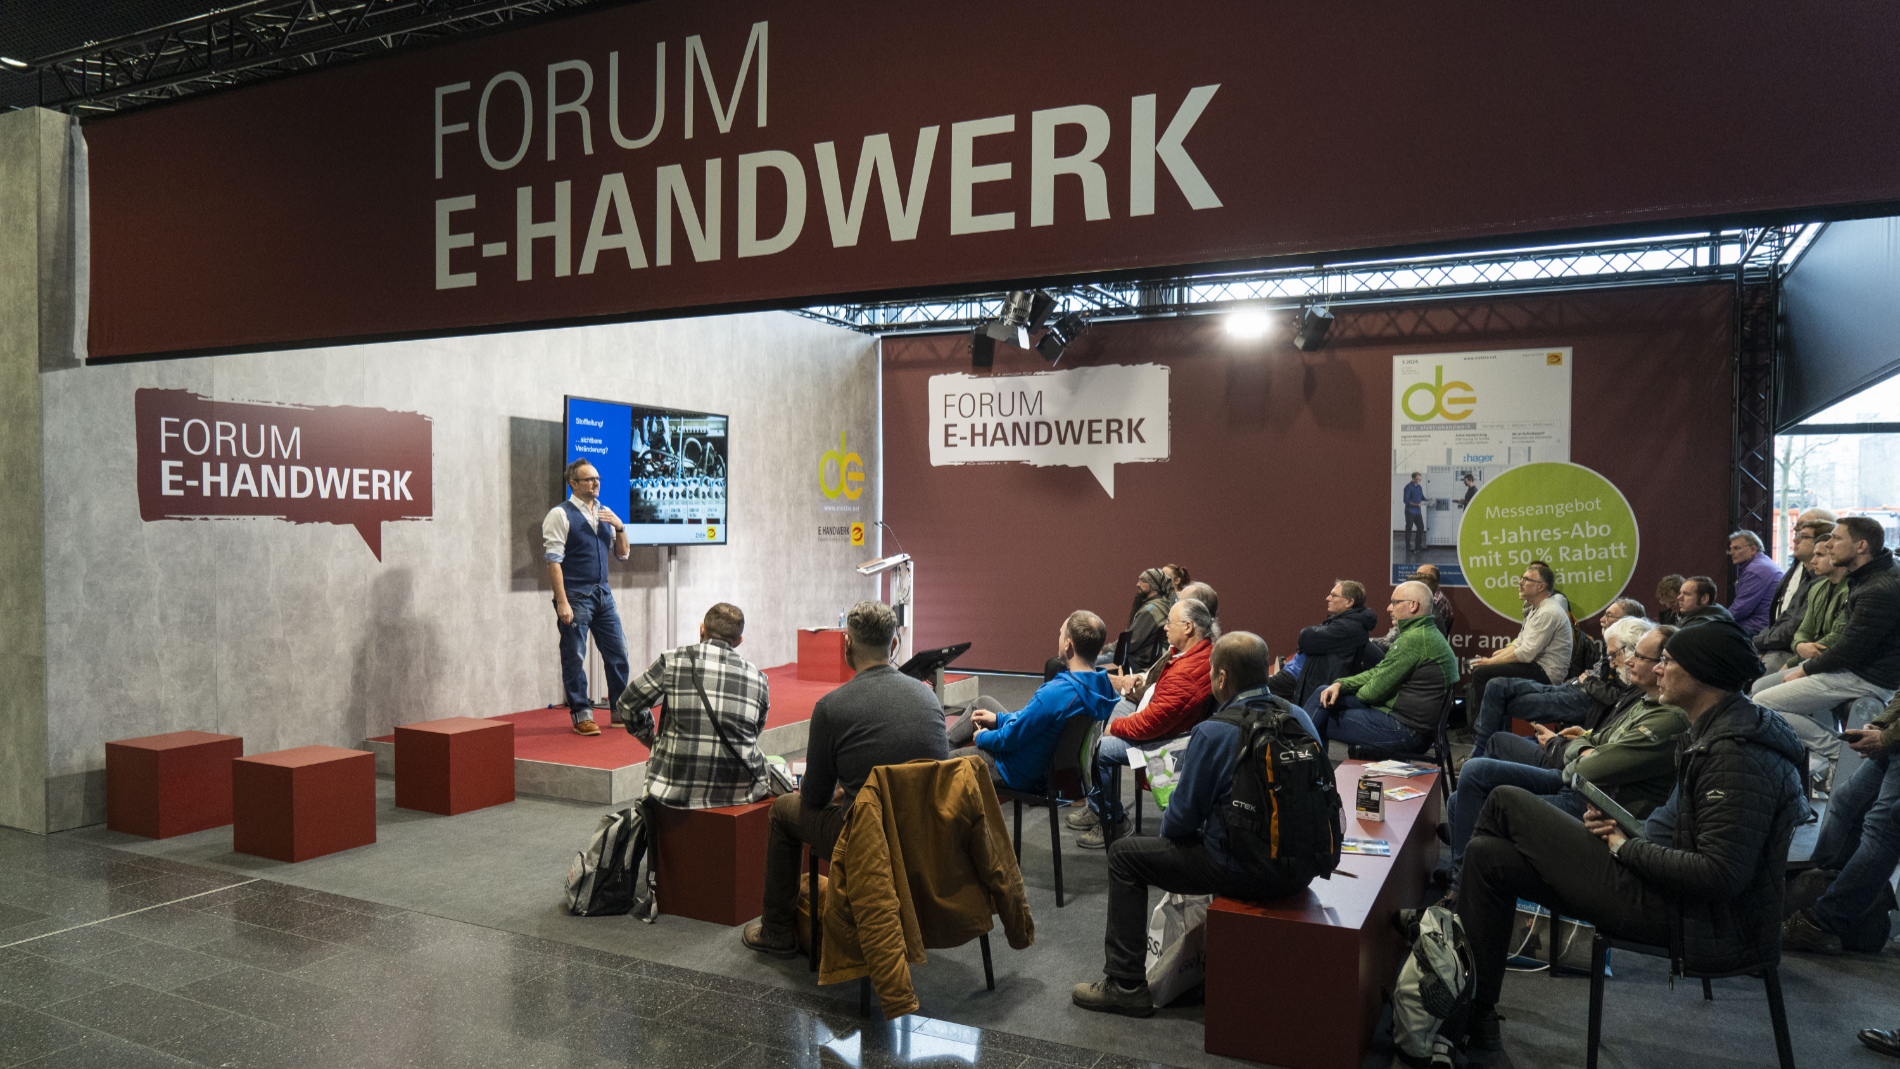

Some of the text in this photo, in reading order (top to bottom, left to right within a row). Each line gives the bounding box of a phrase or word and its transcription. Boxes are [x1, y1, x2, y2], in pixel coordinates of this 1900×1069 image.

[435, 21, 768, 179] FORUM
[435, 83, 1224, 290] E-HANDWERK
[944, 390, 1043, 419] FORUM
[160, 417, 301, 460] FORUM
[944, 417, 1146, 448] E-HANDWERK
[161, 460, 413, 501] E-HANDWERK
[1485, 497, 1602, 519] Messeangebot
[1480, 521, 1611, 546] 1-Jahres-Abo
[1469, 550, 1501, 568] mit
[1558, 542, 1628, 563] Rabatt
[1484, 565, 1613, 589] ode ämie!
[1447, 633, 1511, 649] er am
[1280, 749, 1313, 761] CTEK
[1232, 800, 1257, 812] CTEK
